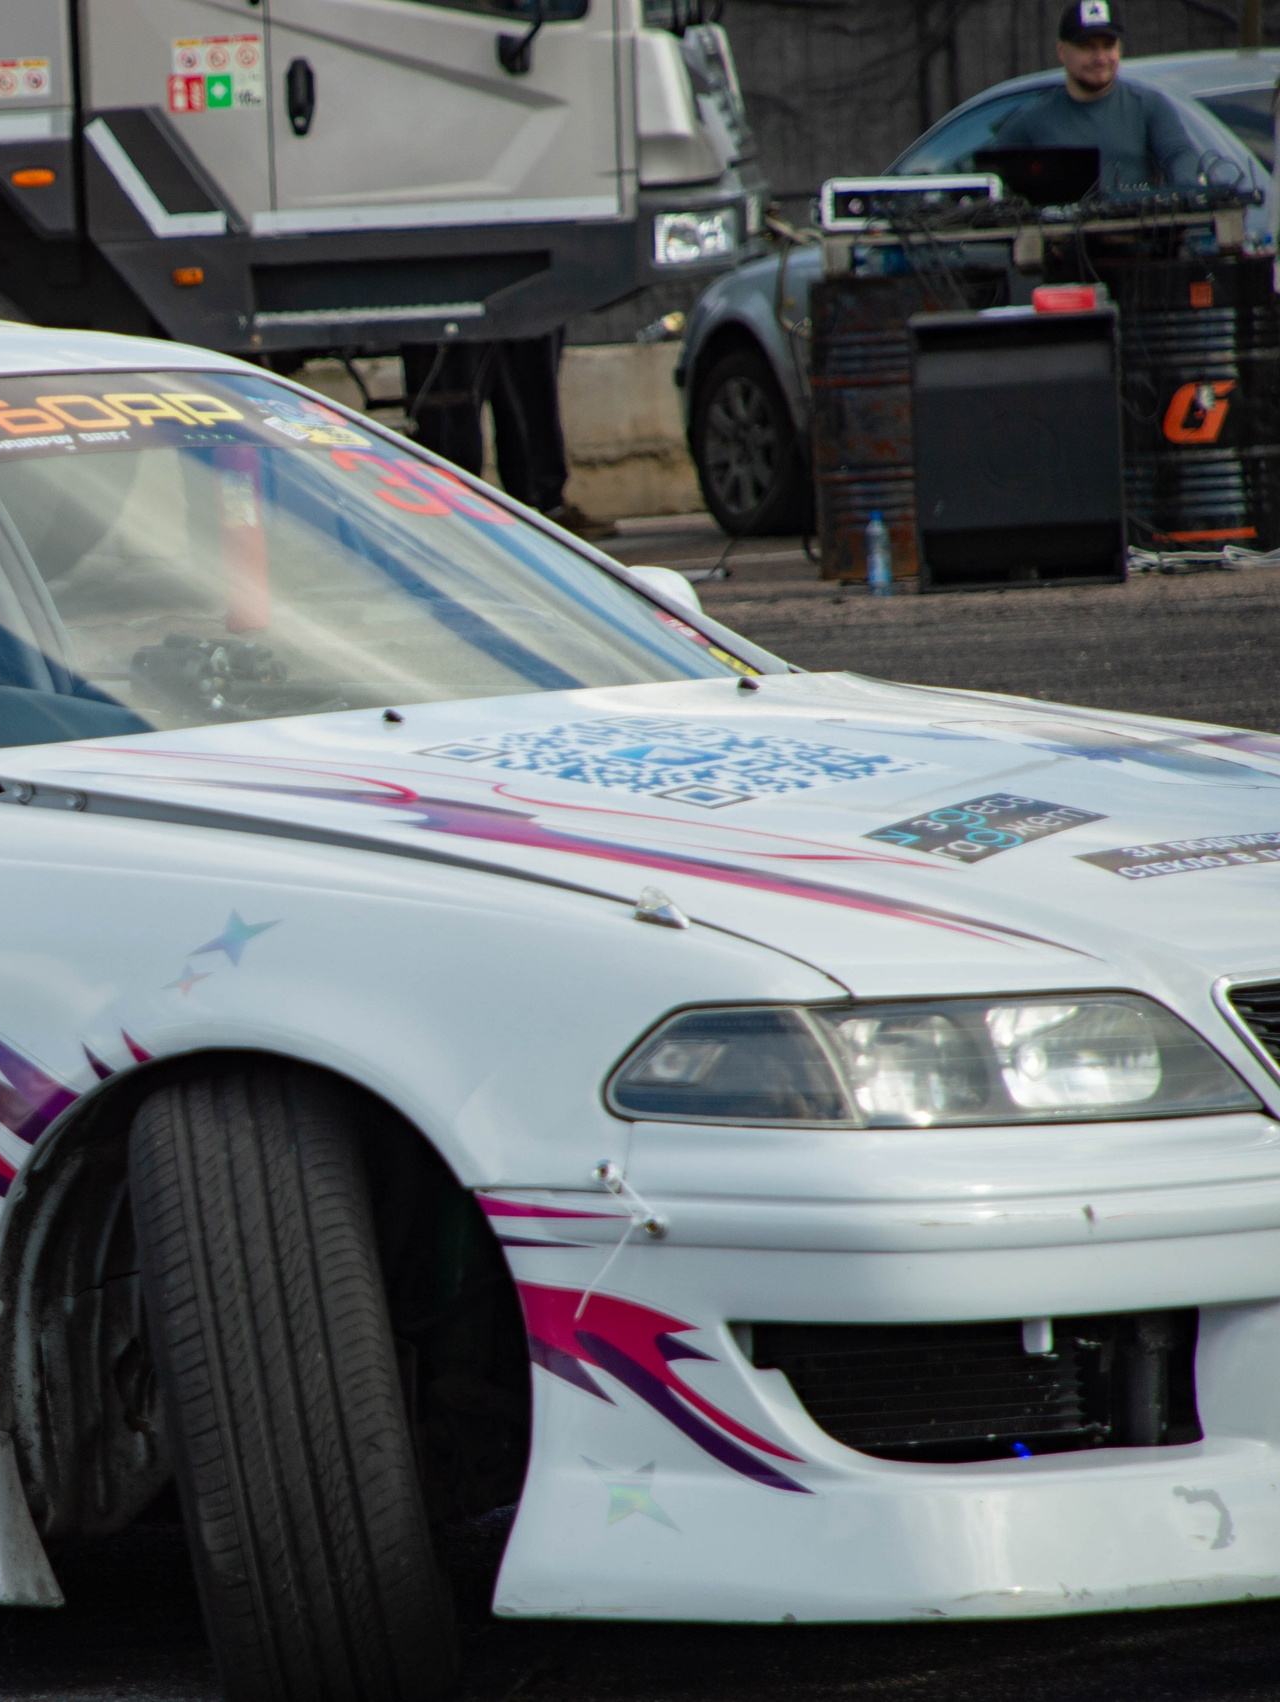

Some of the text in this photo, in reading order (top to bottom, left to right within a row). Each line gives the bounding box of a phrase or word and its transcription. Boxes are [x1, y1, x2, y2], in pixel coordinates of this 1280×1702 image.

[1121, 832, 1280, 858] ЗА ПОДПИС
[1118, 855, 1230, 878] СТЕКЛО
[1226, 851, 1260, 863] В
